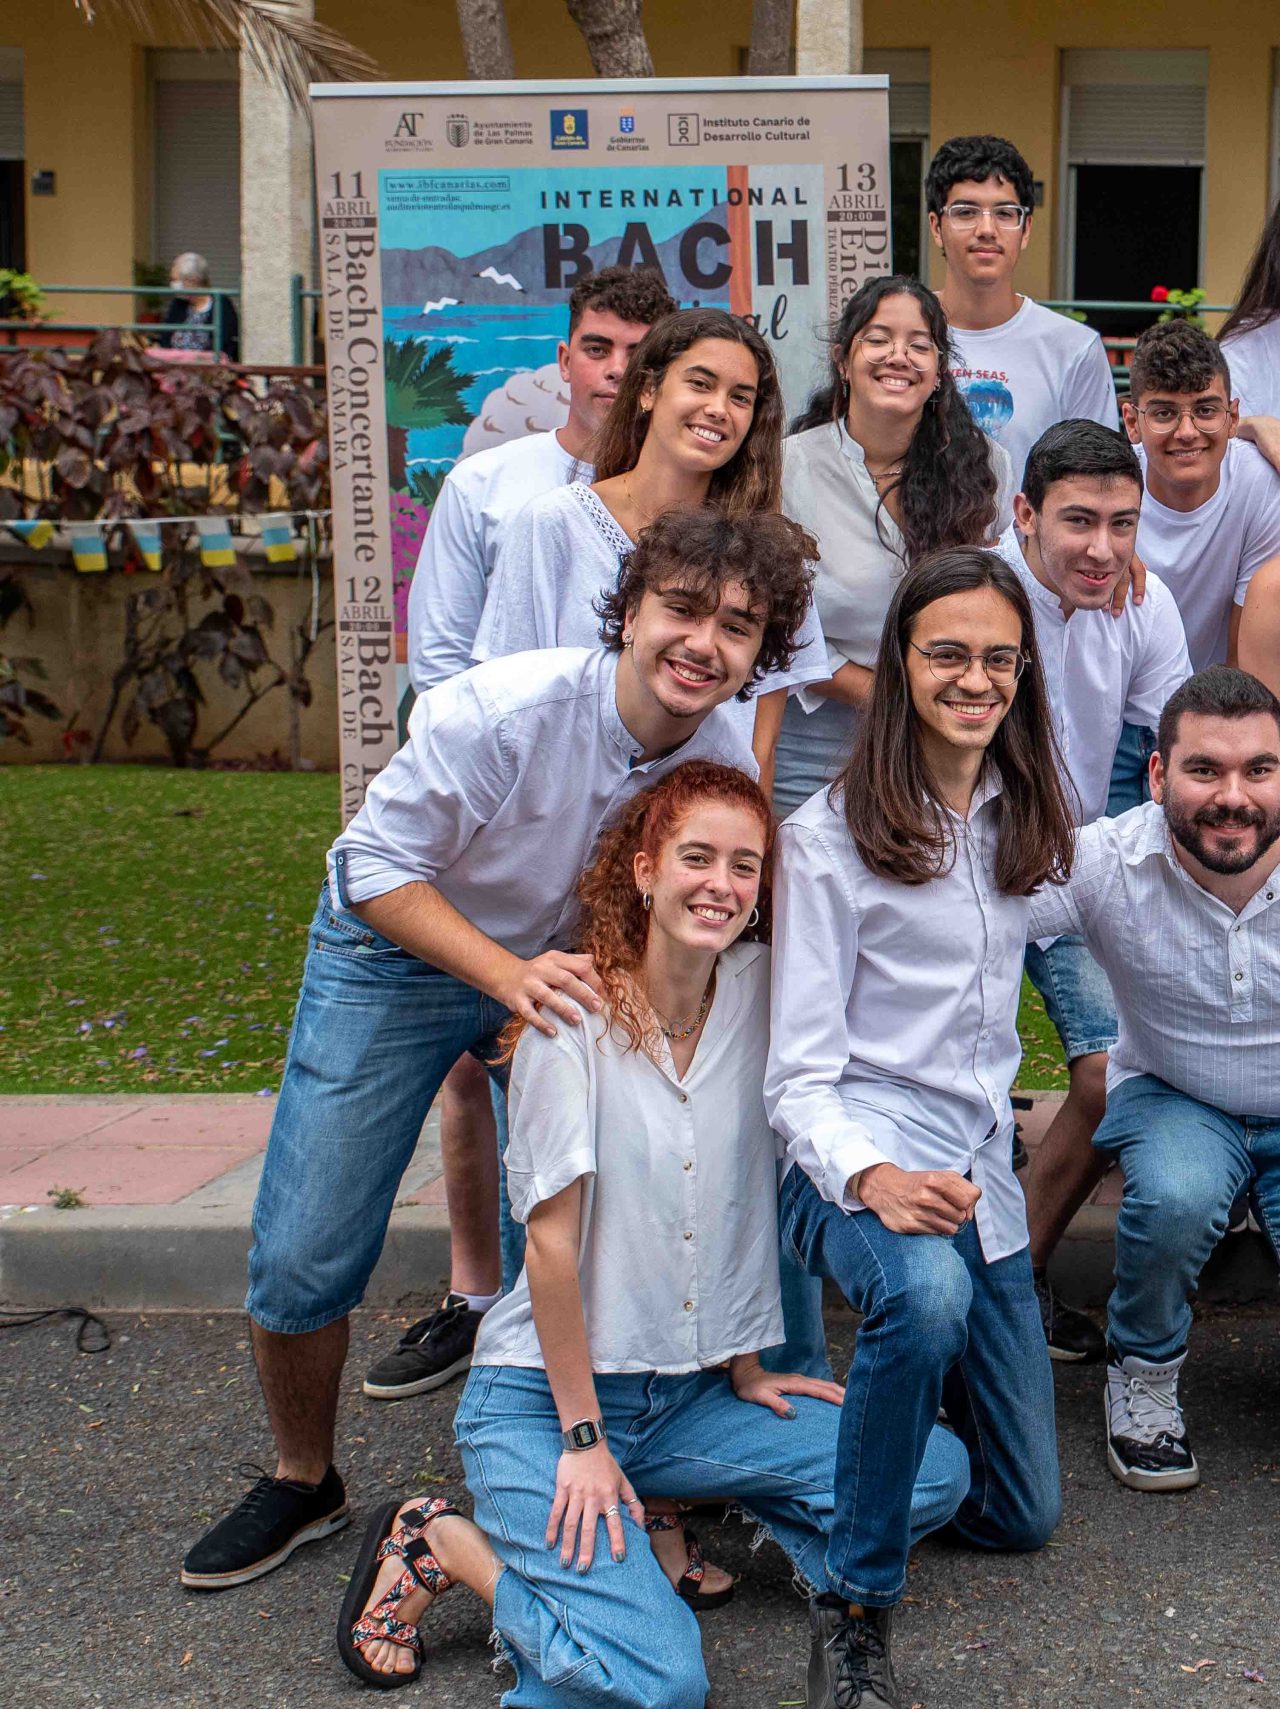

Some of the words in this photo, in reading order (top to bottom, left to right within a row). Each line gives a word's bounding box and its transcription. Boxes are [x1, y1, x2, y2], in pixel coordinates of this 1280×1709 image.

[703, 117, 750, 128] Instituto
[753, 116, 794, 127] Canario
[797, 115, 811, 126] de
[703, 131, 762, 142] Desarrollo
[765, 130, 810, 141] Cultural
[331, 170, 366, 199] 11
[837, 162, 877, 193] 13
[324, 201, 376, 217] ABRIL
[541, 187, 808, 209] INTERNATIONAL
[828, 194, 885, 210] ABRIL
[839, 212, 874, 222] 20:00
[543, 219, 810, 290] BACH
[827, 228, 838, 272] TEATRO
[326, 233, 342, 298] SALA
[345, 231, 378, 329] Bach
[329, 310, 345, 341] DE
[976, 369, 1009, 384] SEAS,
[331, 364, 349, 471] CÁMARA
[347, 336, 379, 563] Concertante
[346, 576, 382, 603] 12
[341, 605, 392, 620] ABRIL
[341, 635, 355, 697] SALA
[357, 634, 395, 749] Bach
[343, 710, 357, 739] DE
[344, 763, 365, 815] CÁM
